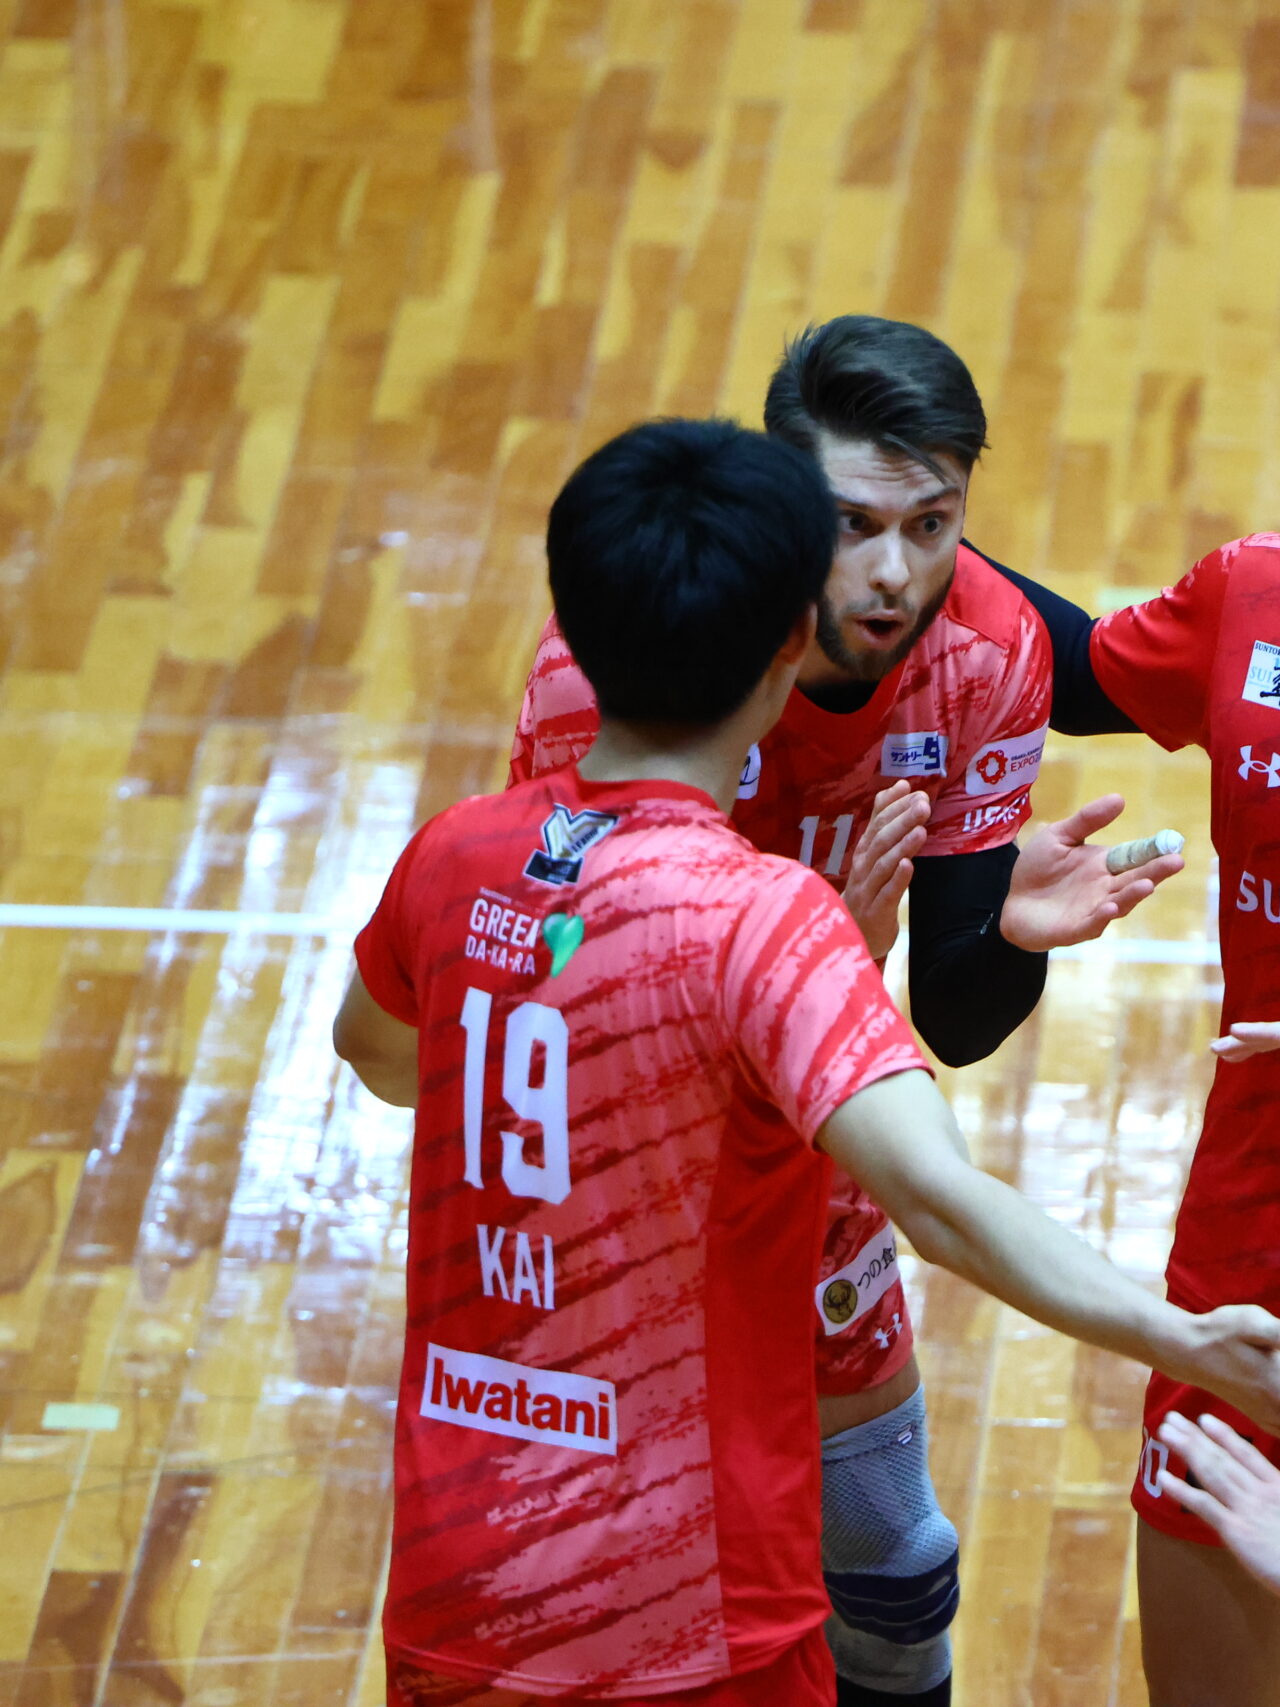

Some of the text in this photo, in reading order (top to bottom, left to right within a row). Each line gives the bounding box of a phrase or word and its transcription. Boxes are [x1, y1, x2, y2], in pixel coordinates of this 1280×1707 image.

[798, 814, 854, 875] 11
[460, 986, 572, 1205] 19
[476, 1224, 555, 1310] KAI
[430, 1357, 610, 1440] Iwatani
